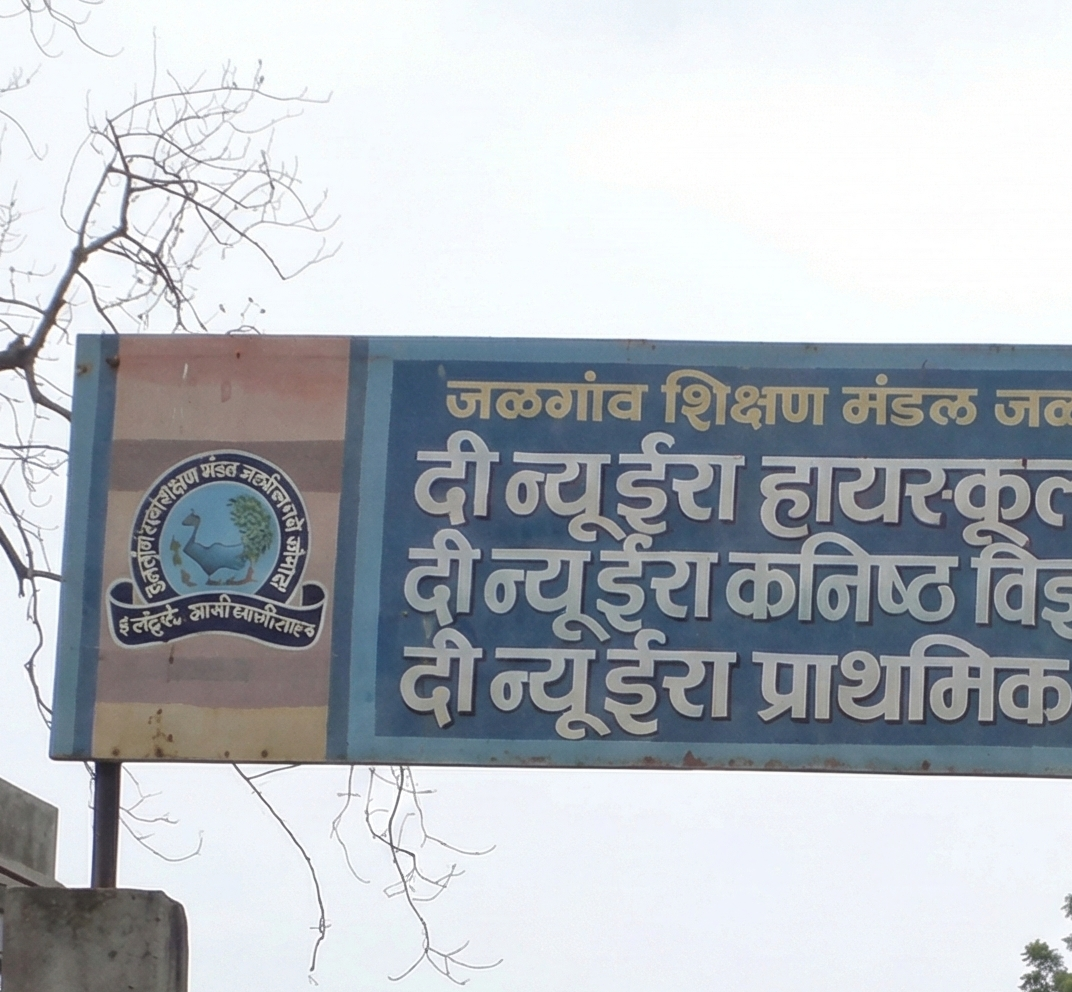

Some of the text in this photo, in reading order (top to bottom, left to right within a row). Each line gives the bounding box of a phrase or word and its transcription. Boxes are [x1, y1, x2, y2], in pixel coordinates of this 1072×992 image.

[446, 370, 649, 424] जळगांव
[660, 369, 830, 431] शिक्षण
[842, 373, 978, 427] मंडल
[414, 430, 500, 526] दी
[504, 451, 627, 542] न्यू
[615, 432, 746, 534] ईरा
[403, 528, 481, 627] दी
[483, 548, 612, 642] न्यू
[596, 533, 719, 633] ईरा
[725, 531, 959, 624] कनिष्ठ
[400, 627, 483, 729] दी
[490, 647, 612, 741] न्यू
[603, 628, 738, 736] ईरा
